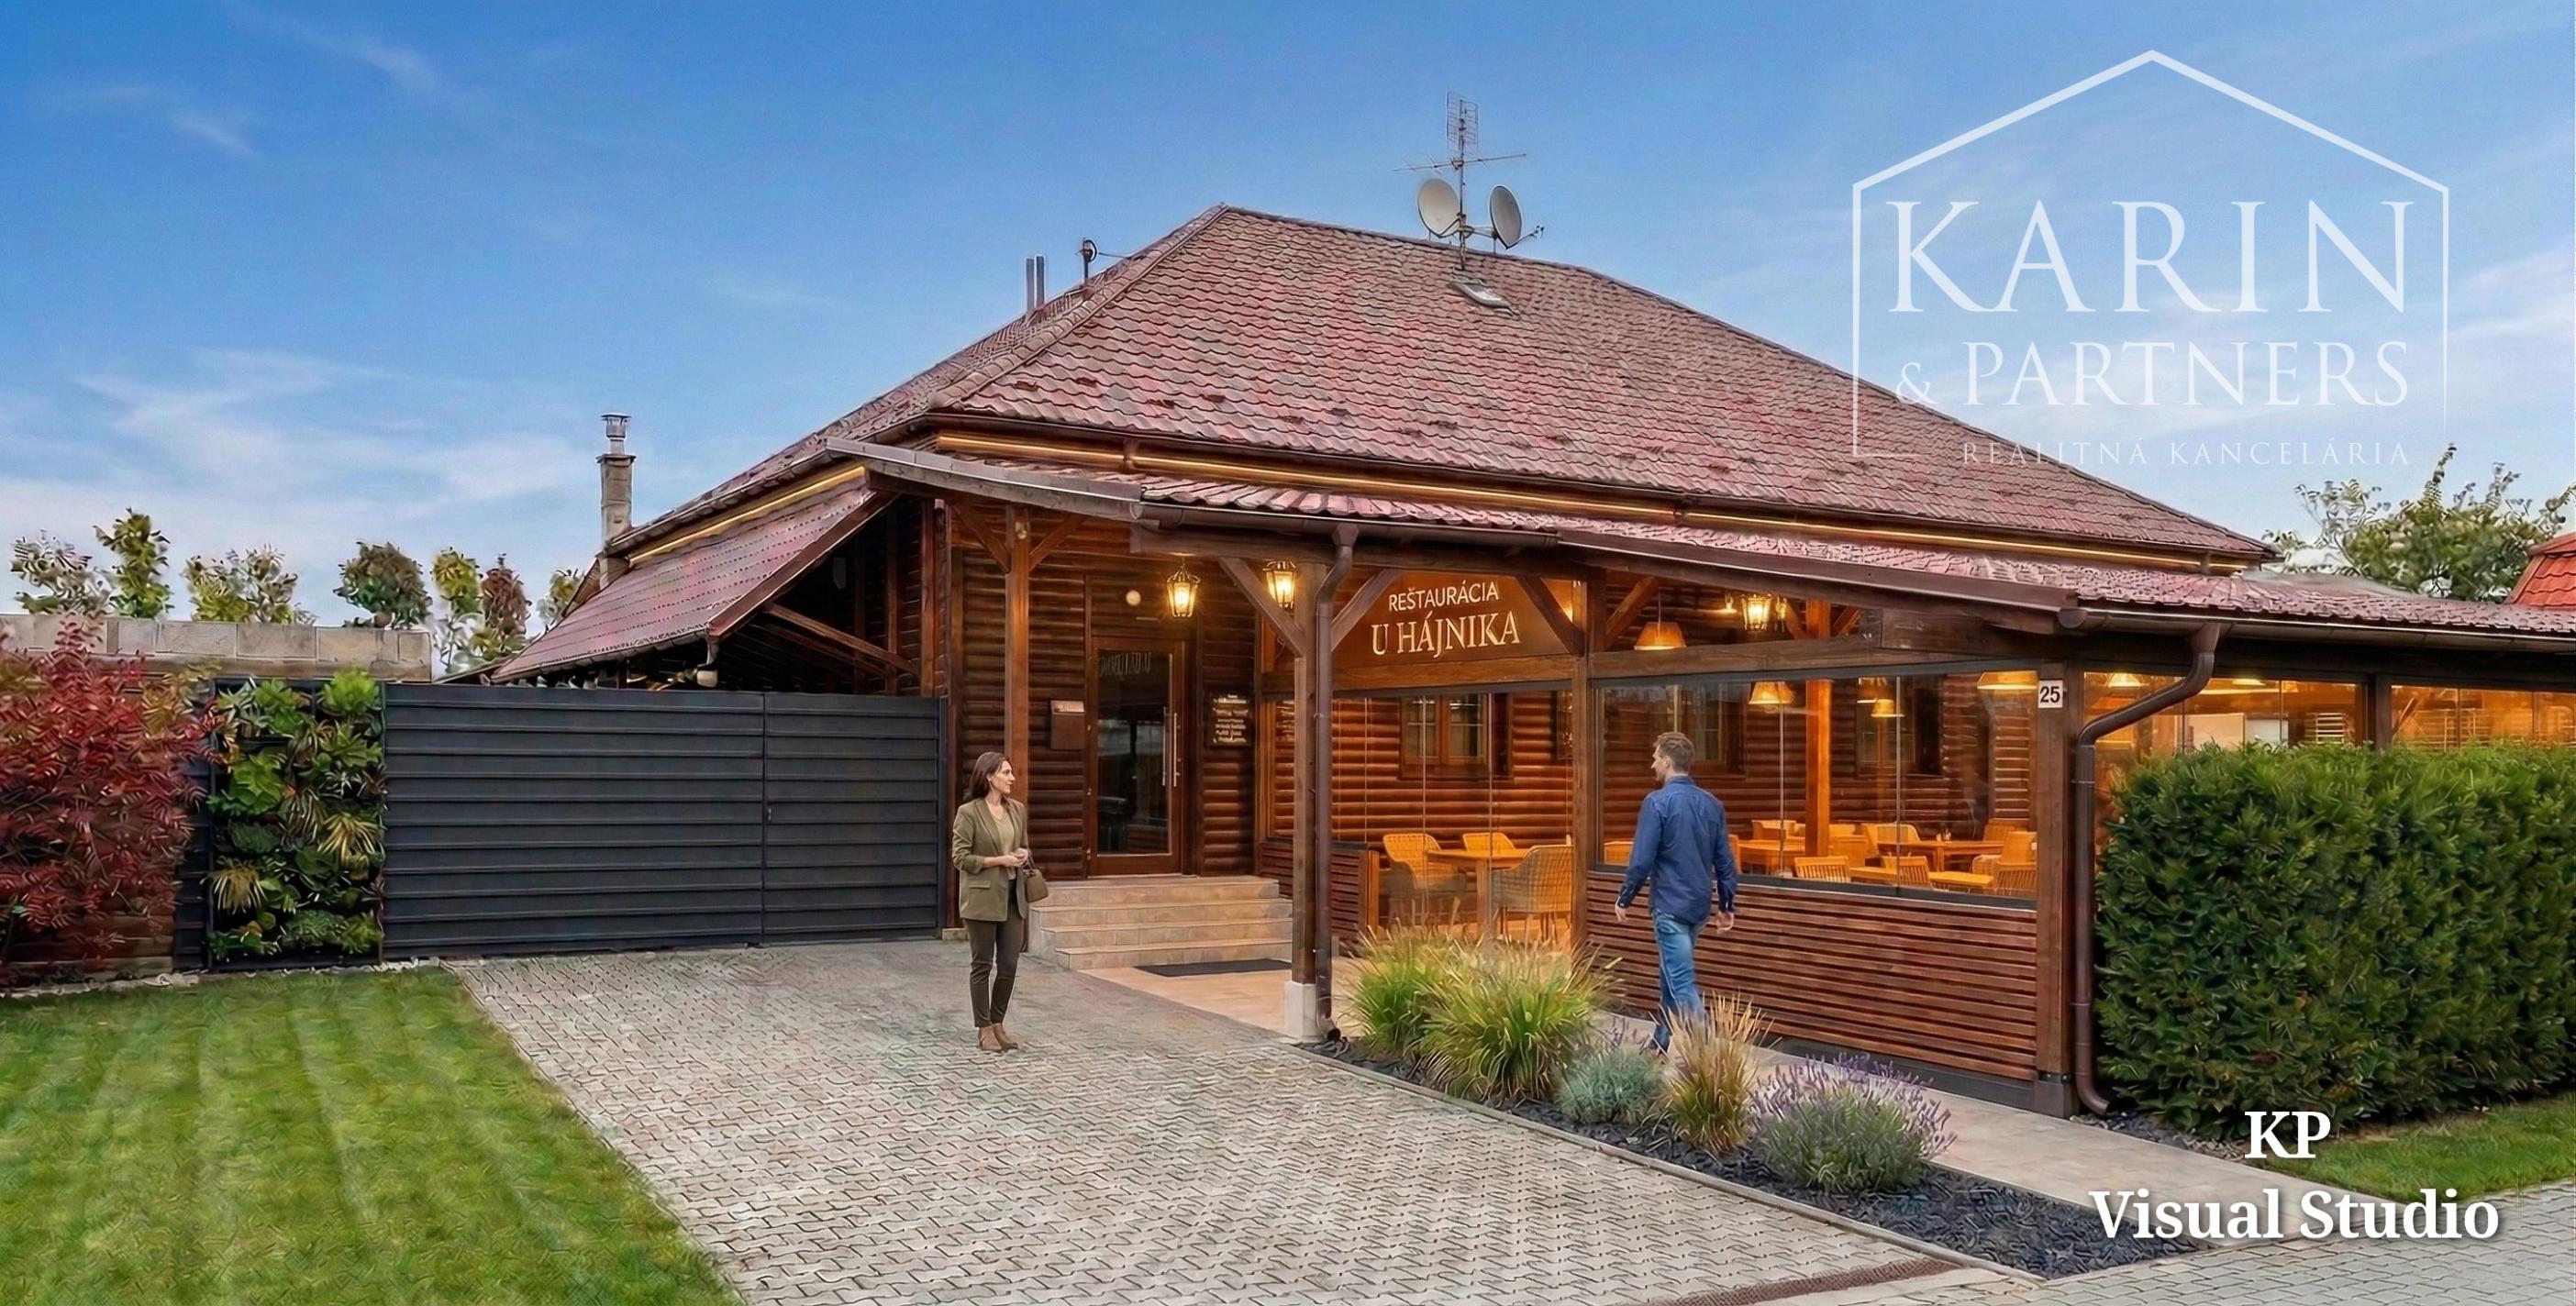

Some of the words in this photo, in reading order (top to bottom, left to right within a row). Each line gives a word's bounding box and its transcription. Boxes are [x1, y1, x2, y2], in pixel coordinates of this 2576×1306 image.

[1388, 580, 1499, 612] REŠTAURÁCIA
[1371, 623, 1388, 656] U
[1396, 611, 1521, 659] HÁJNIKA
[2039, 685, 2060, 703] 25
